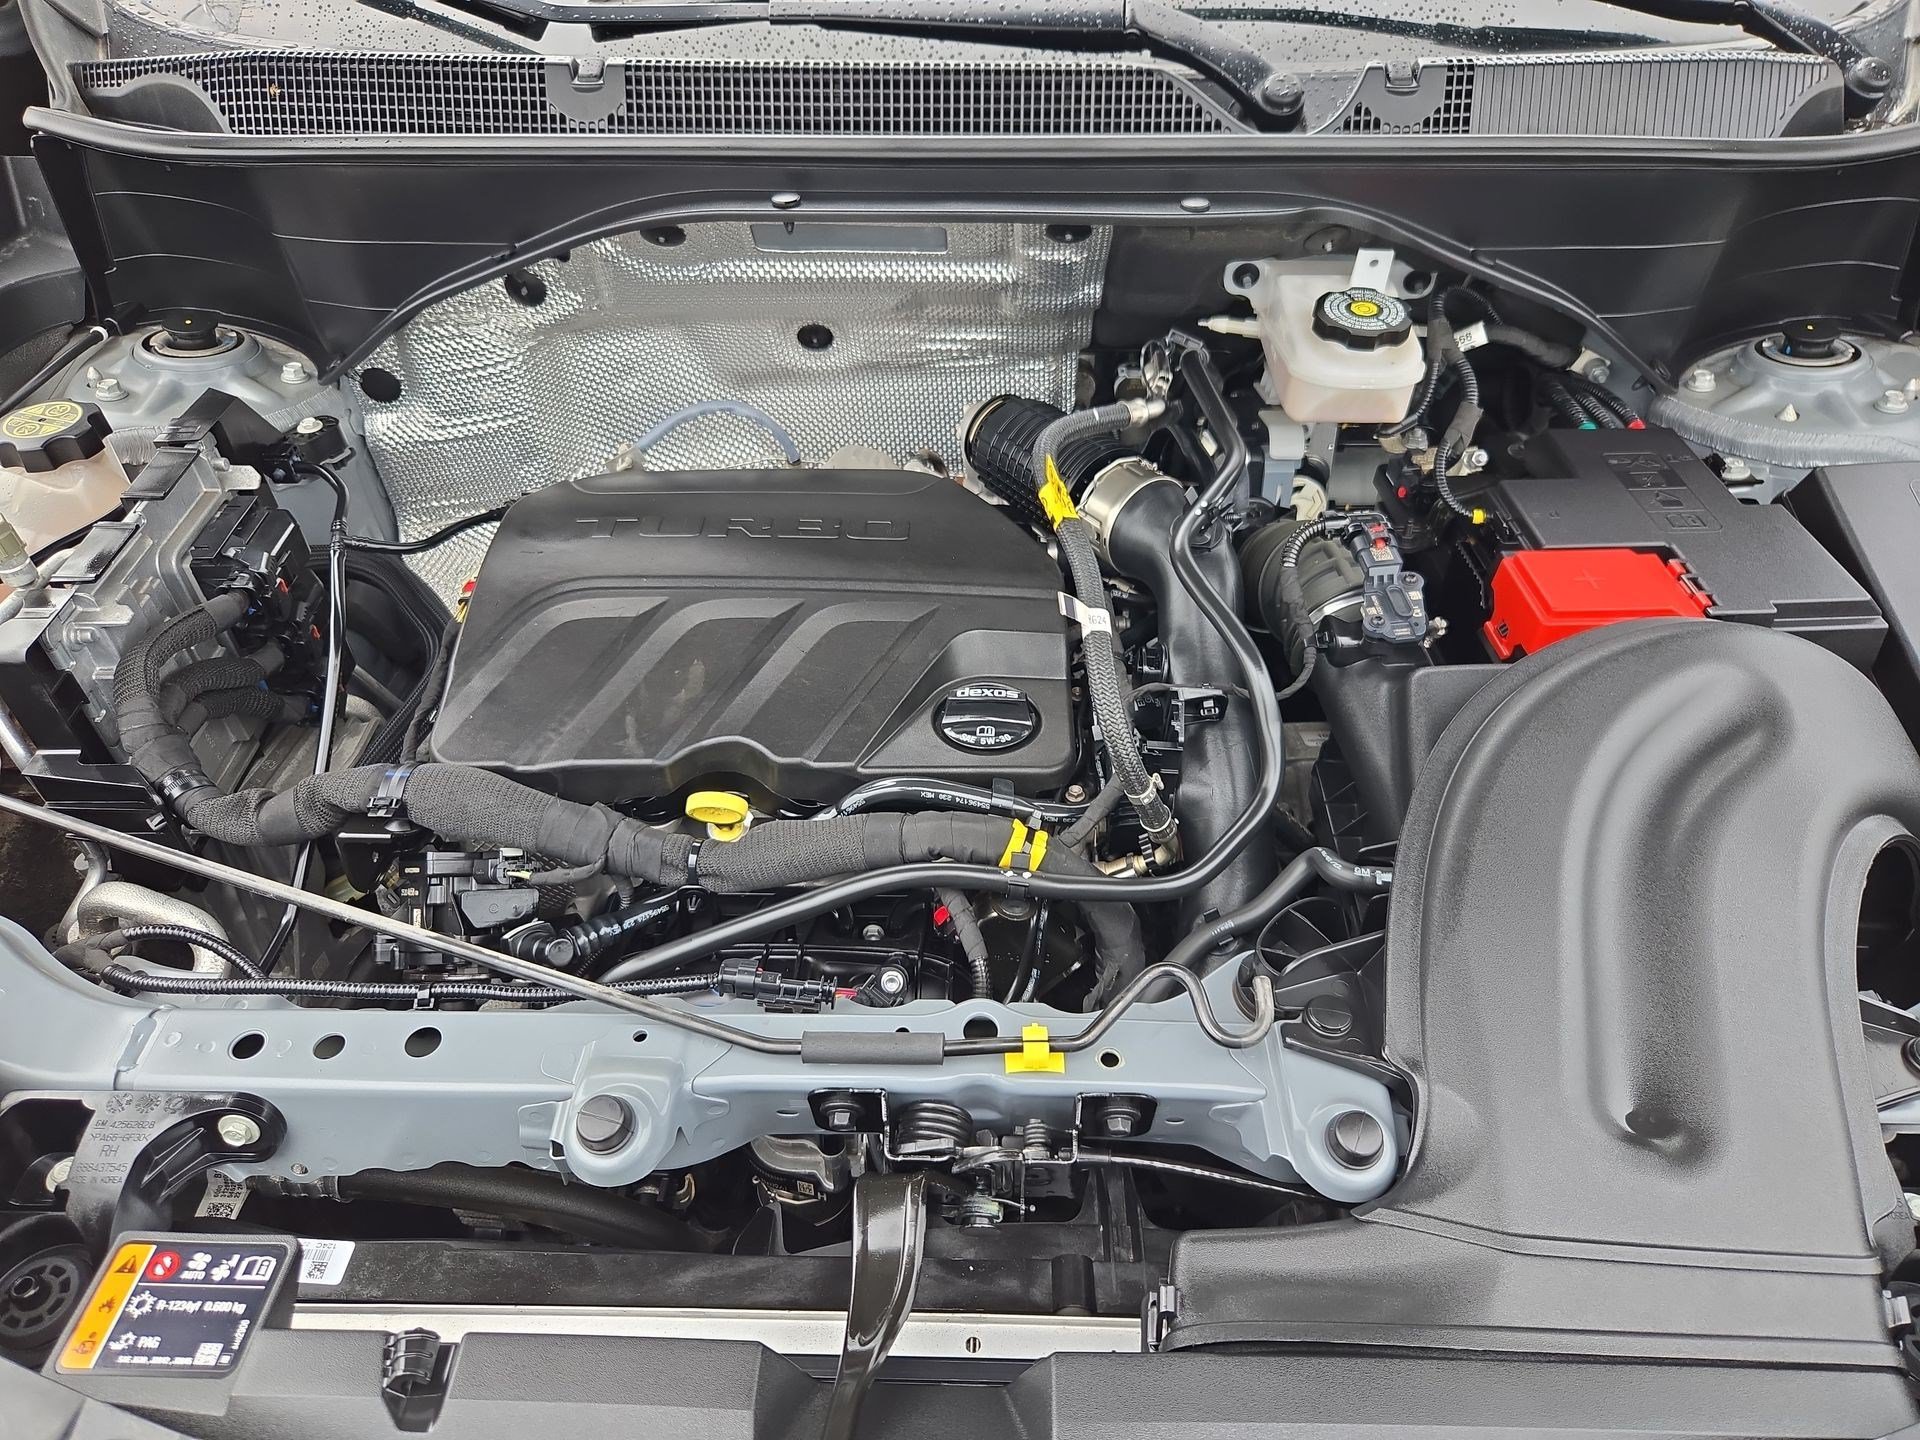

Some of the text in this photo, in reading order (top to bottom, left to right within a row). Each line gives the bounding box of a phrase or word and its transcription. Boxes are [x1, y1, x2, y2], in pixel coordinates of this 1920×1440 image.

[576, 509, 910, 542] TURBO
[956, 687, 1019, 699] dexos
[960, 733, 1012, 745] SAE 5W-30
[99, 1144, 120, 1157] RH
[137, 1336, 162, 1349] PAG
